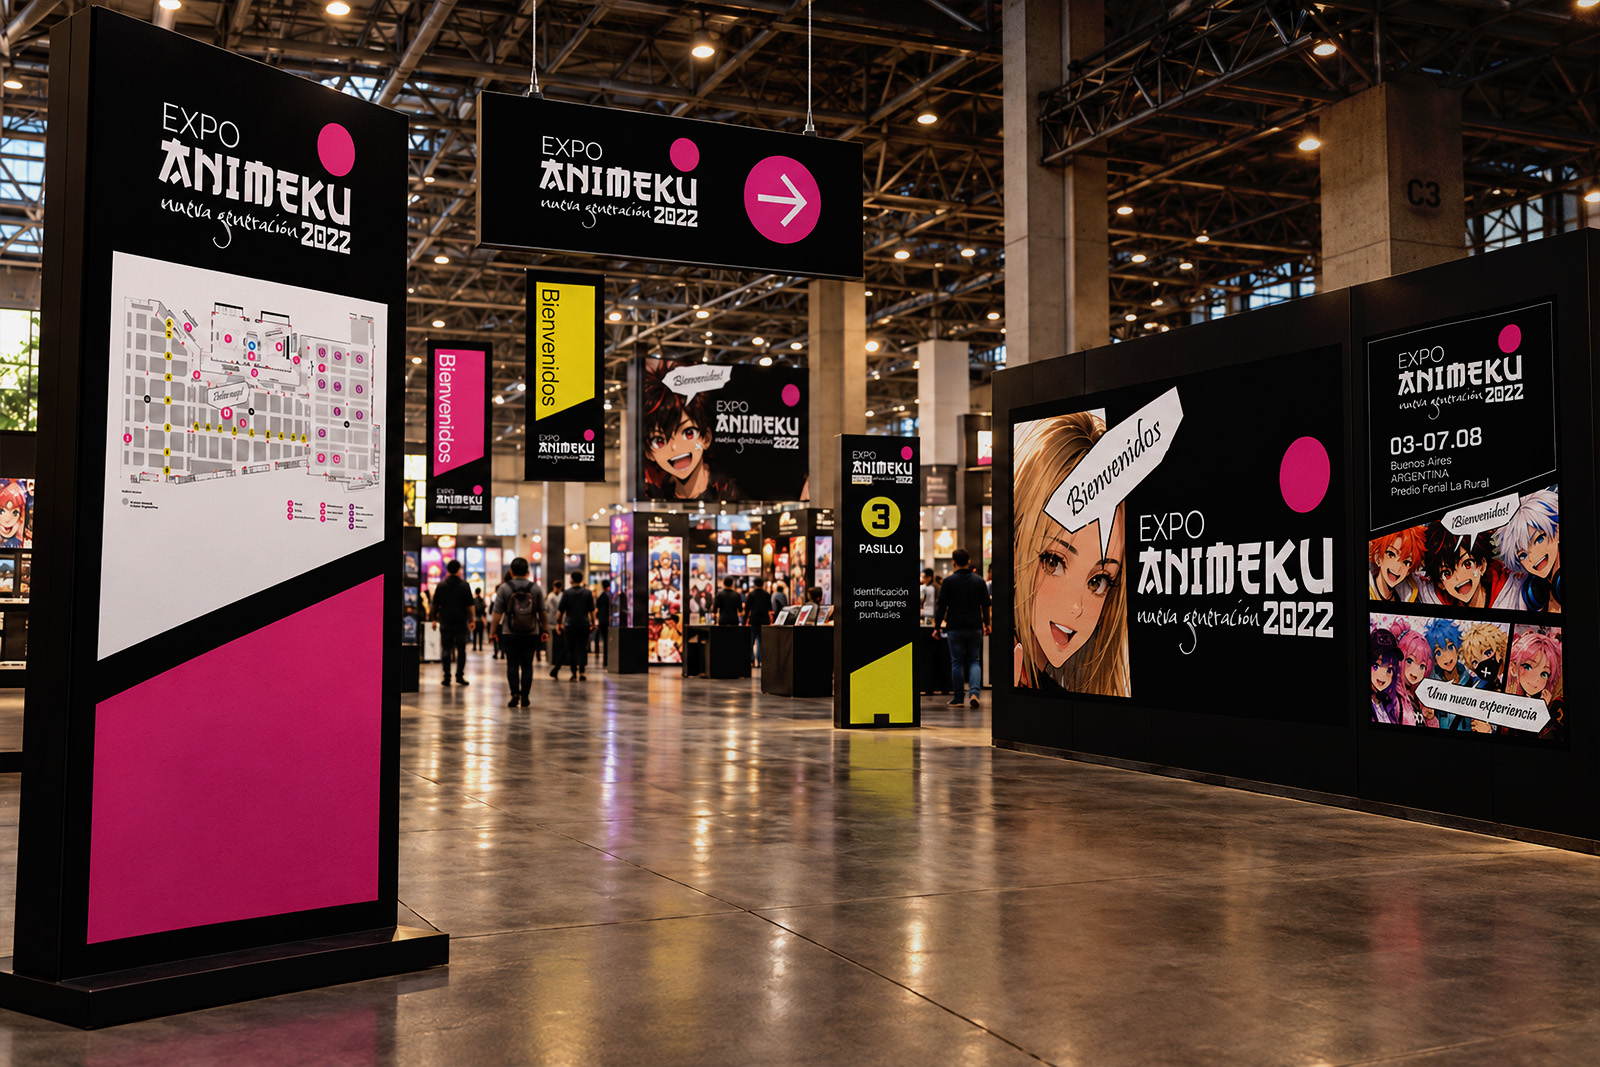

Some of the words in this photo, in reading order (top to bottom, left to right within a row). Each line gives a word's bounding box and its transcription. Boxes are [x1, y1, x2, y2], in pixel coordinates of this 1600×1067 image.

[163, 101, 240, 149] EXPO
[542, 135, 603, 161] EXPO
[158, 137, 351, 226] ANIMEKU
[539, 158, 698, 206] ANIMEKU
[1407, 179, 1441, 208] C3
[161, 198, 212, 219] nueva
[212, 210, 299, 249] generación
[301, 221, 351, 255] 2022
[541, 199, 580, 212] nueva
[581, 201, 652, 229] generación
[653, 205, 699, 228] 2022
[541, 288, 560, 406] Bienvenidos
[1398, 345, 1445, 369] EXPO
[1397, 354, 1523, 396] ANIMEKU
[438, 354, 456, 463] Bienvenidos
[716, 400, 749, 413] EXPO
[1399, 399, 1427, 410] nueva
[1427, 388, 1484, 420] generación
[1485, 383, 1524, 404] 2022
[538, 433, 560, 442] EXPO
[715, 413, 799, 436] ANIMEKU
[538, 441, 595, 454] ANIMEKU
[1390, 426, 1482, 455] 03-07.08
[852, 450, 877, 460] EXPO
[852, 460, 913, 475] ANIMEKU
[1065, 418, 1162, 517] Bienvenidos
[1390, 459, 1425, 471] Buenos
[1427, 455, 1452, 467] Aires
[1390, 468, 1450, 484] ARGENTINA
[1390, 484, 1421, 497] Predio
[1450, 481, 1462, 491] La
[1463, 476, 1490, 490] Rural
[871, 503, 890, 530] 3
[1139, 510, 1205, 542] EXPO
[1451, 502, 1510, 529] ¡Bienvenidos!
[859, 543, 904, 554] PASILLO
[1137, 537, 1334, 595] ANIMEKU
[853, 586, 909, 596] Identificación
[854, 600, 874, 609] para
[875, 599, 907, 610] lugares
[1137, 608, 1178, 627] nueva
[1178, 599, 1261, 655] generación
[1263, 600, 1334, 639] 2022
[1427, 685, 1448, 701] Una
[1449, 693, 1478, 708] nueva
[1479, 699, 1538, 722] experiencia
